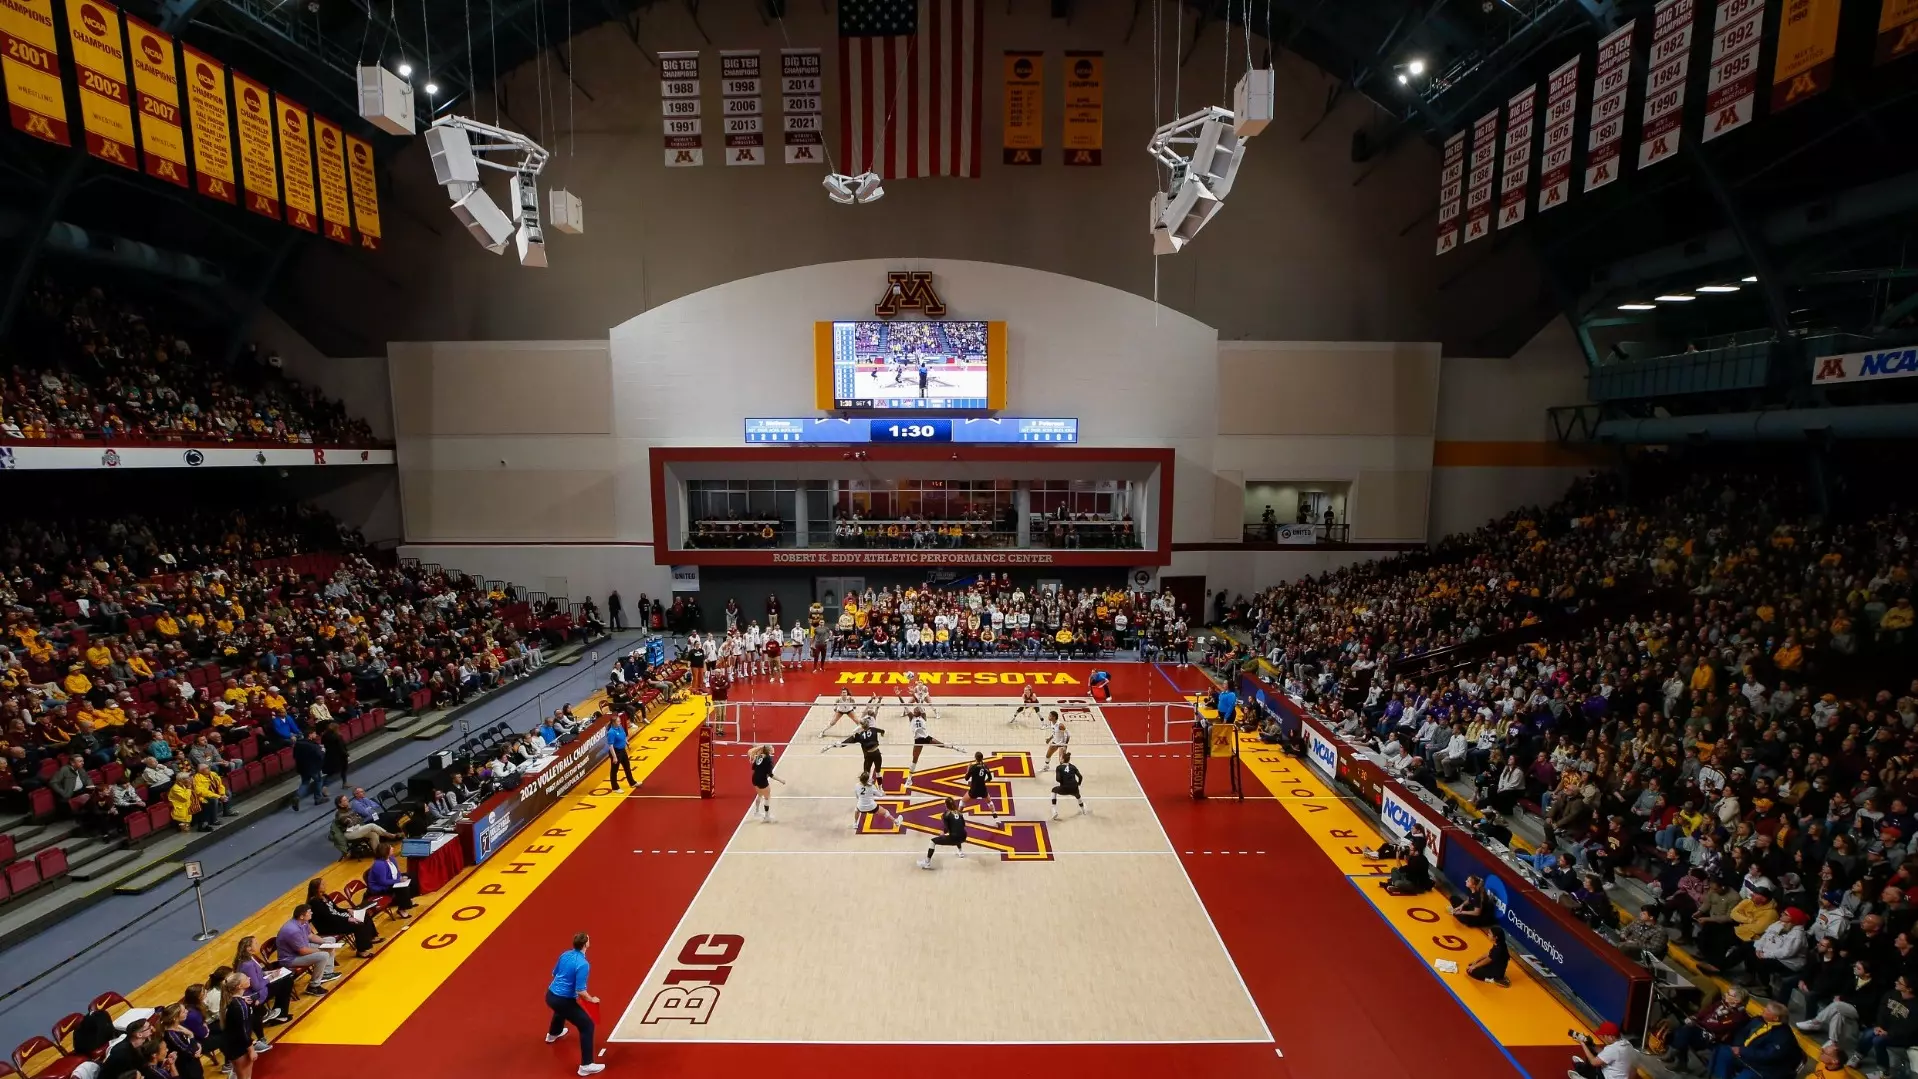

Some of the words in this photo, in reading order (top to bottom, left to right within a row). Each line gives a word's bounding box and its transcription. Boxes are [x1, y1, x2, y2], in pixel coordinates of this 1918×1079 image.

[83, 15, 107, 33] NCAA
[1656, 8, 1673, 29] BIG
[1674, 0, 1693, 18] TEN
[1654, 10, 1693, 40] CHAMPIONS
[73, 29, 122, 60] CHAMPIONS
[1656, 32, 1685, 60] 1982
[1720, 21, 1754, 53] 1992
[8, 38, 49, 69] 2001
[144, 45, 163, 61] NCAA
[1601, 44, 1614, 62] BIG
[1614, 34, 1631, 54] TEN
[663, 60, 678, 70] BIG
[679, 59, 697, 70] TEN
[724, 58, 740, 68] BIG
[741, 57, 758, 68] TEN
[784, 56, 800, 66] BIG
[801, 56, 819, 66] TEN
[784, 66, 819, 75] CHAMPIONS
[1598, 50, 1630, 74] CHAMPIONS
[1716, 53, 1750, 84] 1995
[135, 59, 177, 85] CHAMPIONS
[662, 70, 697, 78] CHAMPIONS
[724, 68, 758, 76] CHAMPIONS
[1550, 76, 1563, 92] BIG
[1563, 68, 1577, 86] TEN
[1600, 69, 1623, 92] 1978
[1653, 61, 1681, 88] 1984
[84, 70, 121, 99] 2002
[668, 82, 694, 94] 1988
[729, 81, 755, 92] 1998
[788, 79, 815, 90] 2014
[1550, 80, 1576, 104] CHAMPIONS
[1785, 70, 1818, 101] M
[192, 85, 224, 106] CHAMPION
[1650, 91, 1678, 116] 1990
[144, 97, 175, 122] 2007
[669, 102, 695, 113] 1989
[730, 100, 756, 112] 2006
[1509, 104, 1521, 120] BIG
[1521, 96, 1534, 113] TEN
[1551, 100, 1571, 121] 1949
[1598, 96, 1620, 118] 1979
[25, 112, 56, 139] M
[241, 109, 269, 127] CHAMPION
[670, 121, 694, 132] 1991
[730, 119, 757, 131] 2013
[790, 118, 815, 129] 2021
[1509, 108, 1533, 127] CHAMPIONS
[1714, 104, 1739, 132] M
[1474, 127, 1485, 141] BIG
[1485, 120, 1496, 135] TEN
[1509, 126, 1528, 145] 1940
[1549, 124, 1569, 145] 1976
[1595, 122, 1617, 144] 1980
[101, 139, 127, 164] M
[675, 150, 694, 163] M
[735, 148, 755, 161] M
[794, 147, 814, 159] M
[1508, 148, 1526, 166] 1947
[1547, 149, 1567, 168] 1977
[1648, 137, 1669, 161] M
[157, 159, 180, 181] M
[1473, 168, 1489, 184] 1936
[1506, 170, 1524, 188] 1948
[1592, 164, 1610, 184] M
[208, 179, 229, 198] M
[1545, 186, 1560, 206] M
[255, 195, 273, 214] M
[1505, 205, 1518, 223] M
[295, 211, 311, 228] M
[1470, 220, 1482, 237] M
[331, 224, 345, 240] M
[1442, 234, 1452, 250] M
[874, 271, 947, 316] M
[1816, 358, 1846, 380] M
[1859, 350, 1918, 376] NCA
[888, 425, 935, 438] 1:30
[773, 553, 816, 563] ROBERT
[818, 553, 830, 563] K.
[832, 553, 861, 563] EDDY
[862, 553, 918, 563] ATHLETIC
[919, 553, 1006, 563] PERFORMANCE
[1008, 553, 1053, 563] CENTER
[674, 572, 696, 580] UNITED
[835, 671, 1081, 684] MINNESOTA
[1214, 736, 1229, 746] M
[1313, 738, 1335, 769] NCAA
[700, 742, 711, 791] MINNESOTA
[1064, 766, 1070, 774] 4
[1194, 743, 1204, 791] MINNESOTA
[520, 782, 538, 802] 2022
[537, 755, 574, 788] VOLLEYBALL
[545, 784, 557, 796] FIRST
[860, 788, 867, 796] 2
[420, 827, 574, 950] GOPHER
[1330, 828, 1469, 952] GOHER
[1507, 909, 1564, 964] Championships
